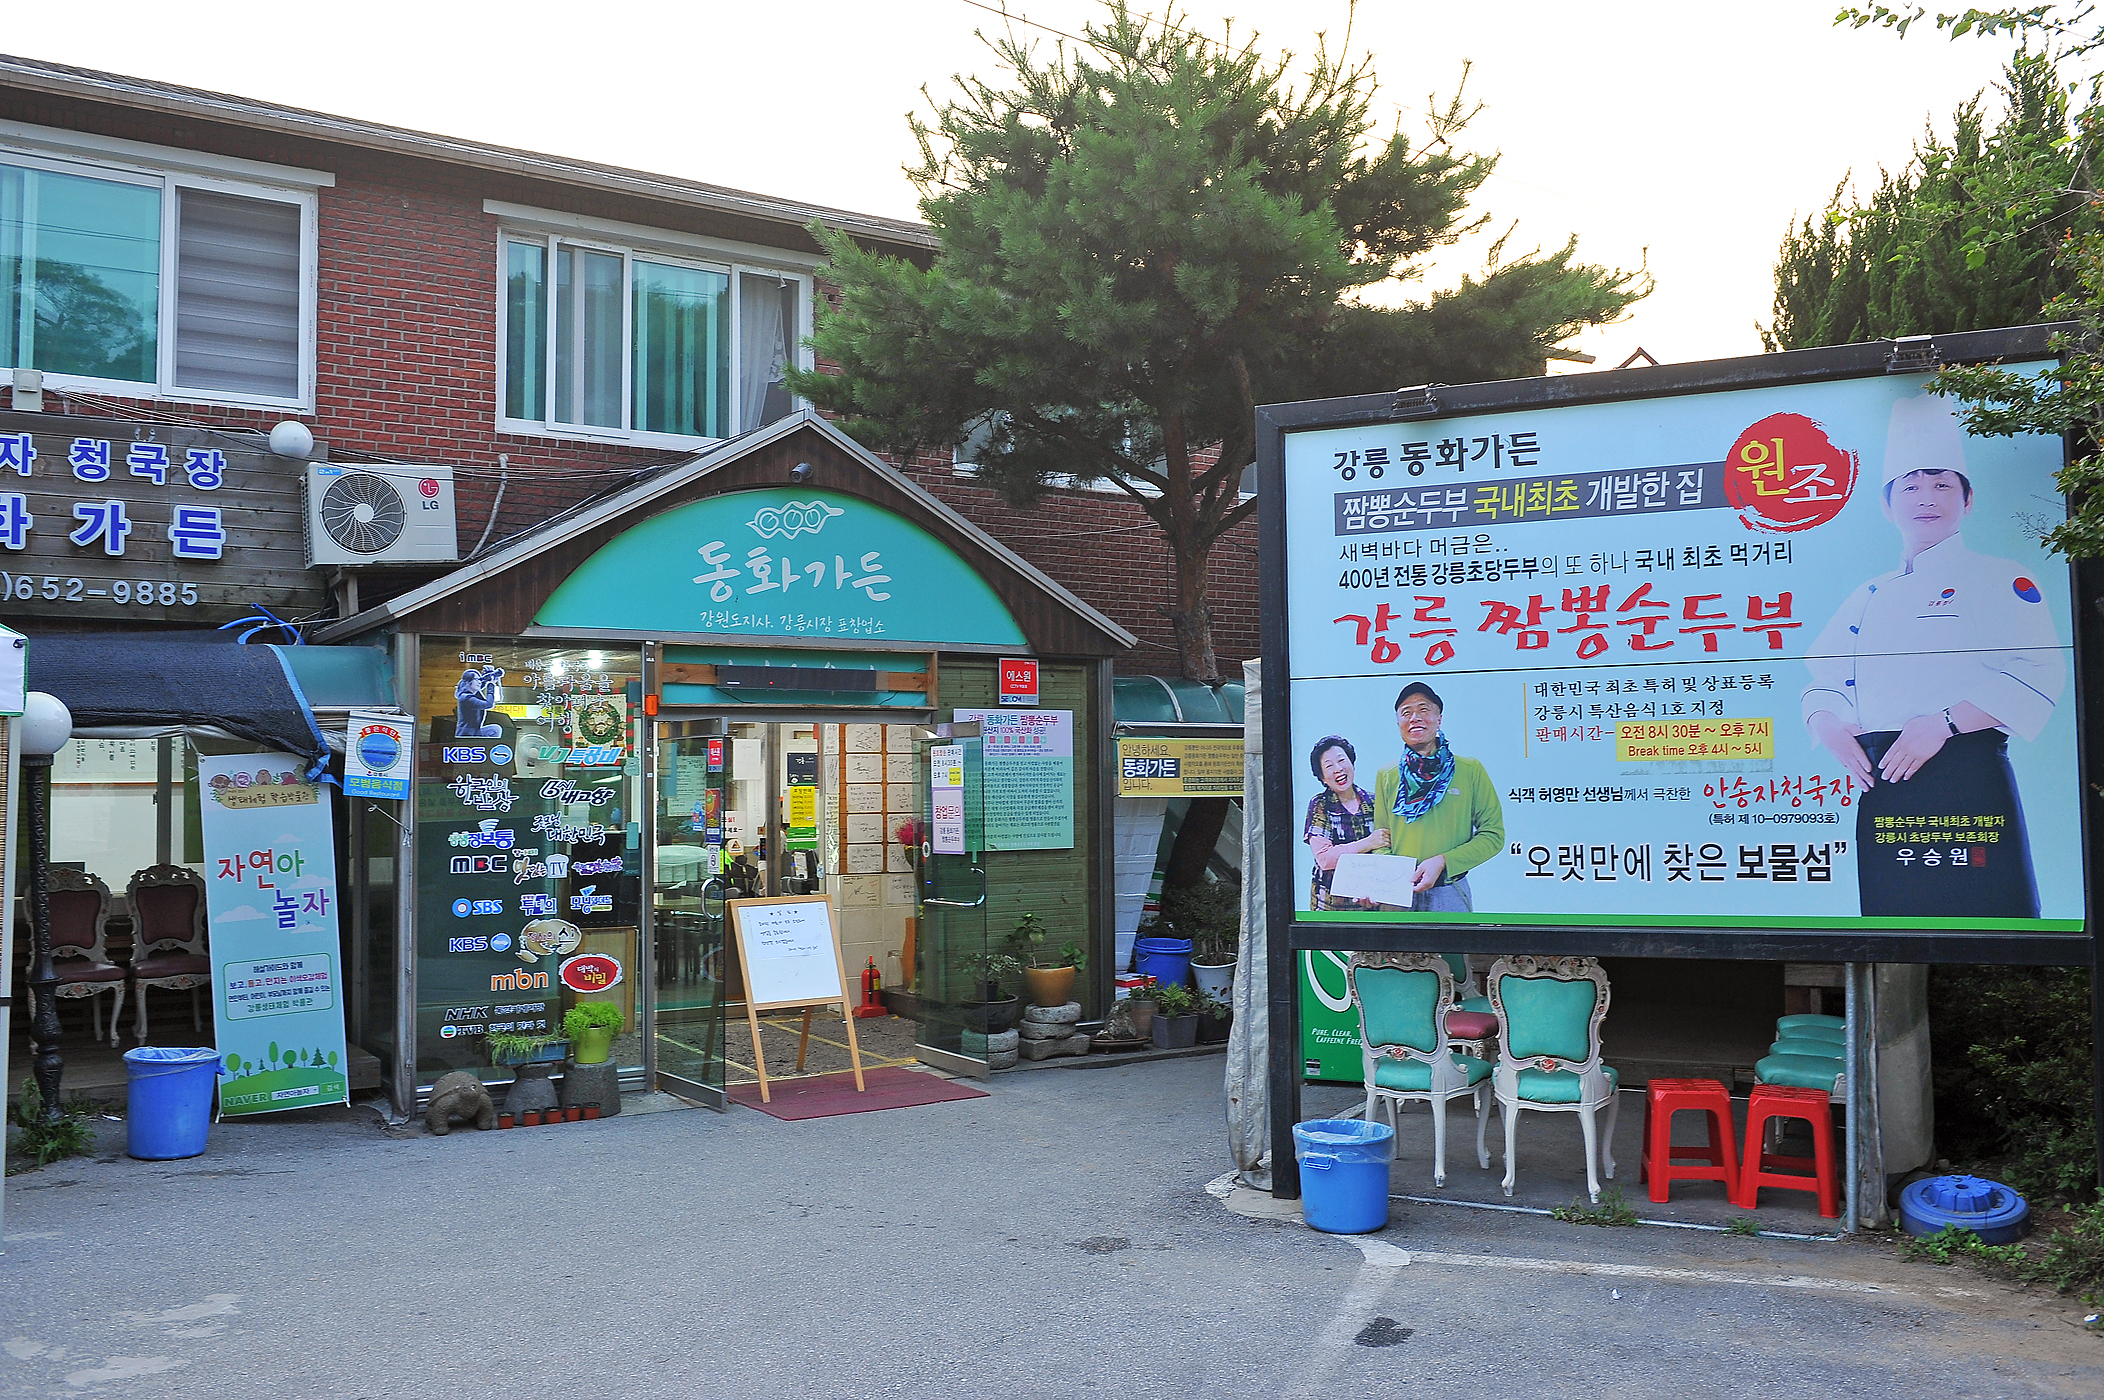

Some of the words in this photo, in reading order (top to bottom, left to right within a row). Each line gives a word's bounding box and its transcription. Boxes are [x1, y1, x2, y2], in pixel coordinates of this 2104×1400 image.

[68, 437, 227, 490] 청국장
[1333, 447, 1391, 481] 강릉
[1400, 432, 1541, 476] 동화가든
[1736, 437, 1843, 503] 원조
[422, 500, 439, 510] LG
[1342, 488, 1469, 531] 짬뽕순두부
[1473, 479, 1580, 520] 국내최초
[1585, 470, 1670, 511] 개발한
[1675, 468, 1704, 505] 집
[1338, 538, 1423, 563] 새벽바다
[1430, 533, 1508, 556] 머금은..
[693, 541, 892, 602] 동화가든
[1338, 567, 1389, 589] 400년
[1393, 565, 1428, 588] 전통
[1431, 553, 1559, 585] 강릉초당두부의
[1564, 555, 1584, 576] 또
[1589, 550, 1629, 576] 하나
[1634, 547, 1676, 573] 국내
[1682, 545, 1723, 570] 최초
[1730, 539, 1793, 567] 먹거리
[700, 610, 773, 628] 강원도지사.
[780, 613, 833, 632] 강릉시장
[838, 617, 885, 634] 표창업소
[1333, 595, 1458, 666] 강릉
[1477, 582, 1802, 660] 짬뽕순두부
[1006, 670, 1031, 682] 에스원
[1533, 680, 1601, 698] 대한민국
[1605, 678, 1639, 697] 최초
[1642, 677, 1676, 695] 특허
[1682, 676, 1697, 694] 및
[1702, 673, 1775, 692] 상표등록
[1533, 704, 1583, 721] 강릉시
[1588, 701, 1656, 720] 특산음식
[1661, 700, 1687, 717] 1호
[1690, 698, 1724, 716] 지정
[987, 714, 1018, 726] 동화가든
[1020, 714, 1059, 726] 짬뽕순두부
[1620, 723, 1645, 740] 오전
[1648, 722, 1669, 739] 8시
[1672, 722, 1701, 739] 30분
[1720, 722, 1745, 738] 오후
[1748, 721, 1769, 737] 7시
[443, 746, 487, 763] KBS
[1122, 744, 1171, 757] 안녕하세요.
[1628, 744, 1659, 757] Break
[1662, 743, 1685, 756] time
[1688, 743, 1709, 756] 오후
[1712, 742, 1729, 756] 4시
[1744, 742, 1762, 755] 5시
[1123, 758, 1177, 778] 동화가든
[349, 777, 404, 791] 모범음식점
[1123, 778, 1153, 791] 입니다.
[1508, 787, 1535, 803] 식객
[1538, 786, 1579, 803] 허영만
[1582, 786, 1649, 803] 선생님께서
[1653, 786, 1691, 801] 극찬한
[1703, 775, 1855, 809] 안송자청국장
[1708, 813, 1735, 826] (특허
[1738, 812, 1750, 826] 제
[1874, 816, 1926, 828] 짬뽕순두부
[1928, 815, 1971, 828] 국내최초
[1973, 815, 2005, 828] 개발자
[545, 824, 607, 846] 대한민국
[1875, 832, 1907, 844] 강릉시
[1909, 832, 1953, 844] 초당두부
[1955, 831, 2000, 844] 보존회장
[217, 849, 305, 889] 자연아
[450, 854, 508, 874] MBC
[1663, 843, 1727, 882] 찾은
[272, 888, 330, 930] 놀자
[472, 900, 504, 915] SBS
[449, 936, 489, 953] KBS
[491, 968, 549, 992] mbn
[445, 1006, 490, 1022] NHK
[457, 1024, 484, 1036] TVB
[1315, 1035, 1344, 1045] CAFFEINE
[224, 1092, 269, 1108] NAVER
